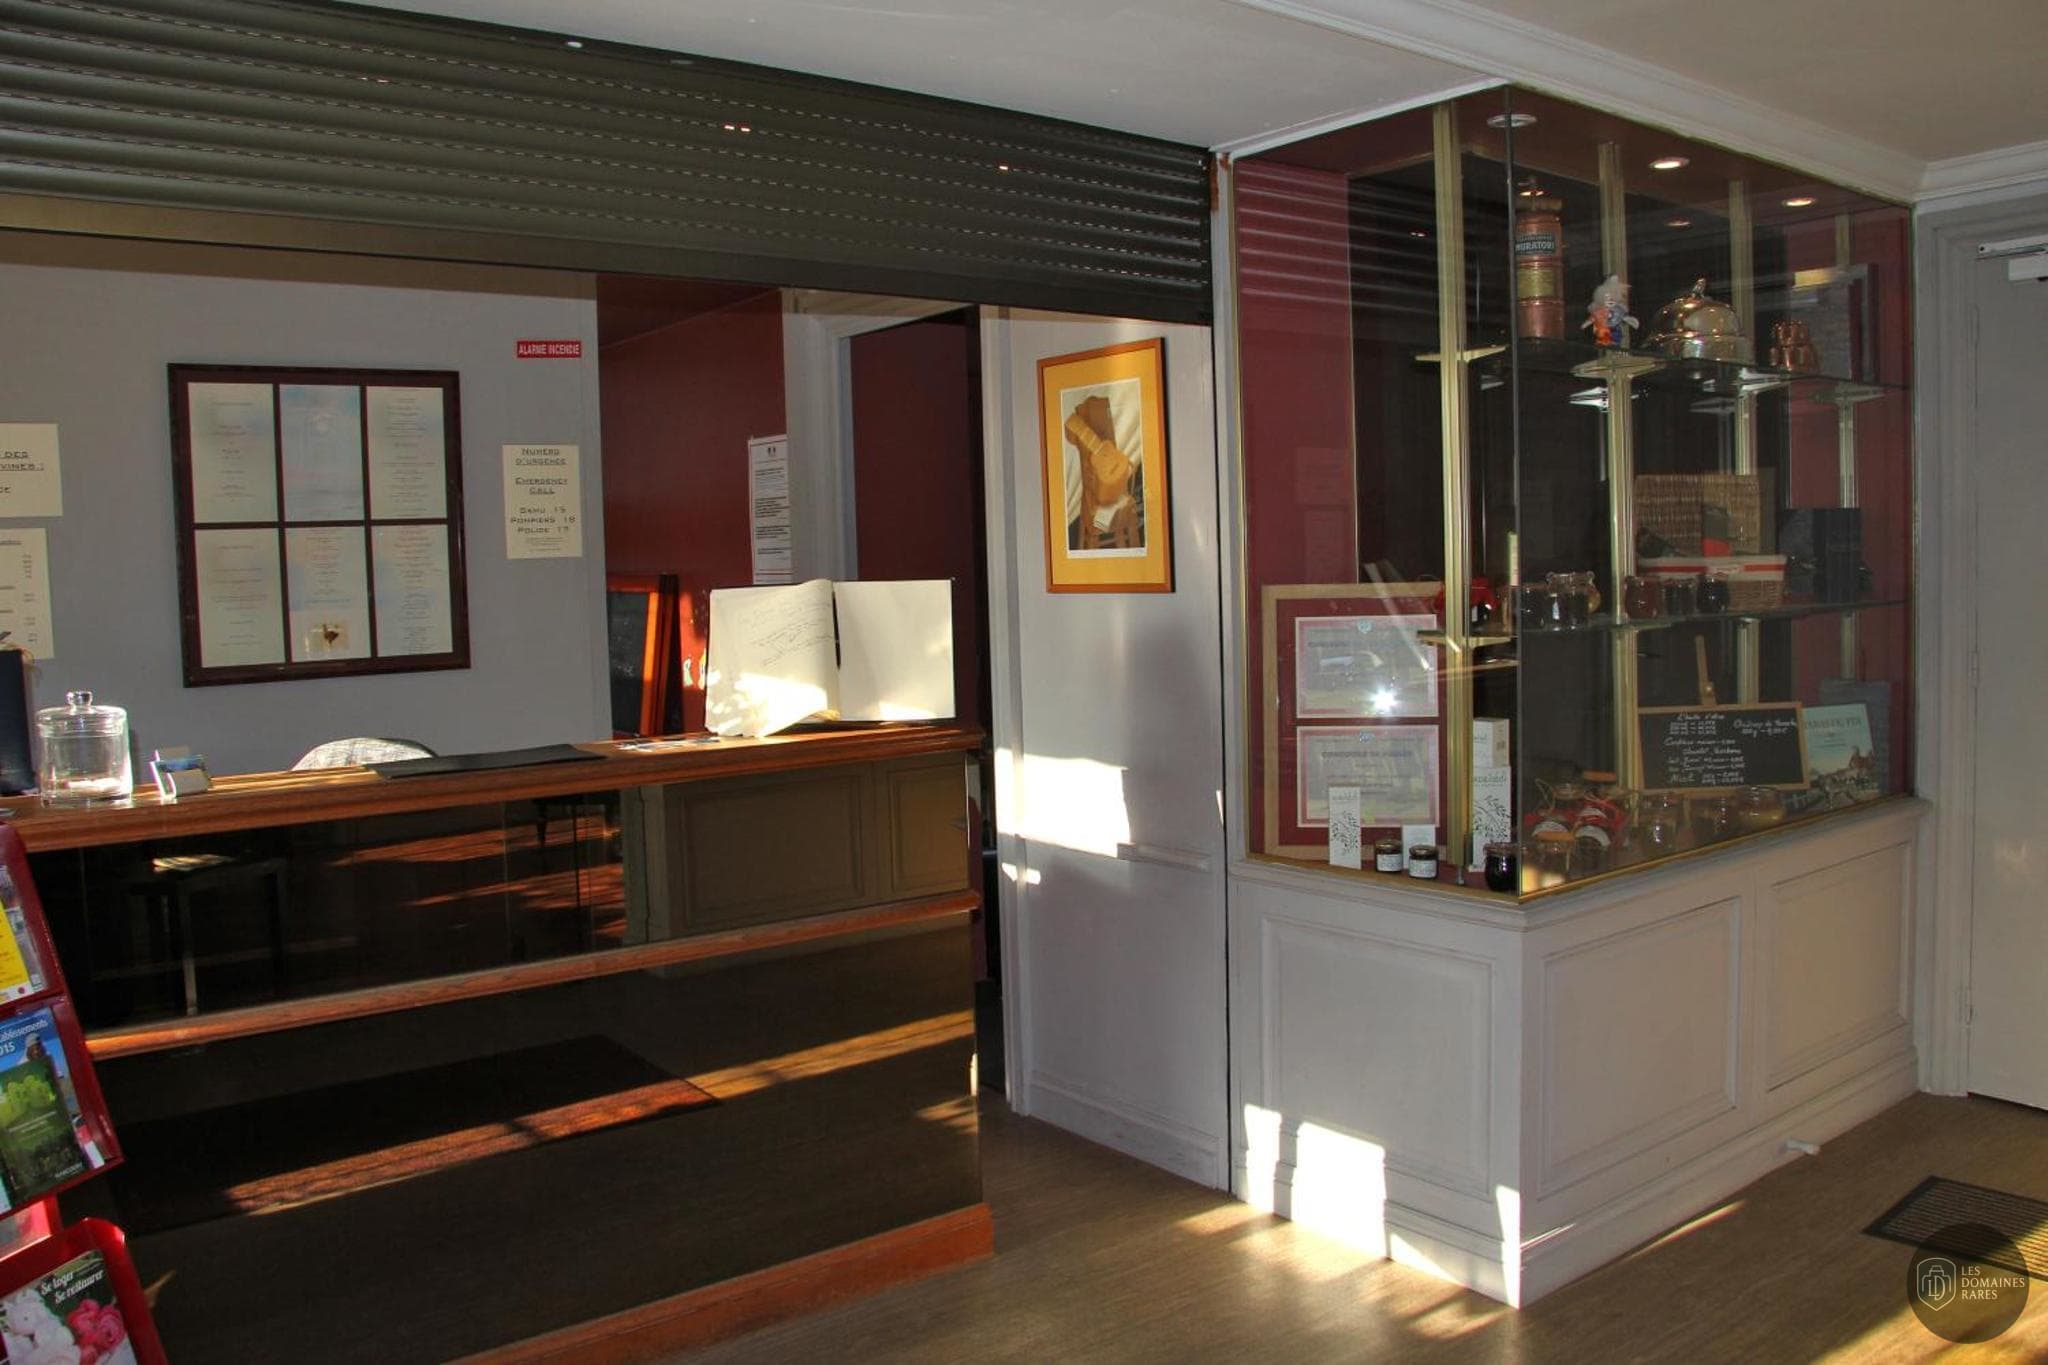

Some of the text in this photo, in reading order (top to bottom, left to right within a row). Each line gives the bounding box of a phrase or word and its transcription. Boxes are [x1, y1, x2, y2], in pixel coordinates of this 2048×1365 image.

[519, 344, 580, 355] ALARME INCENDIE
[66, 1270, 103, 1297] restaurer
